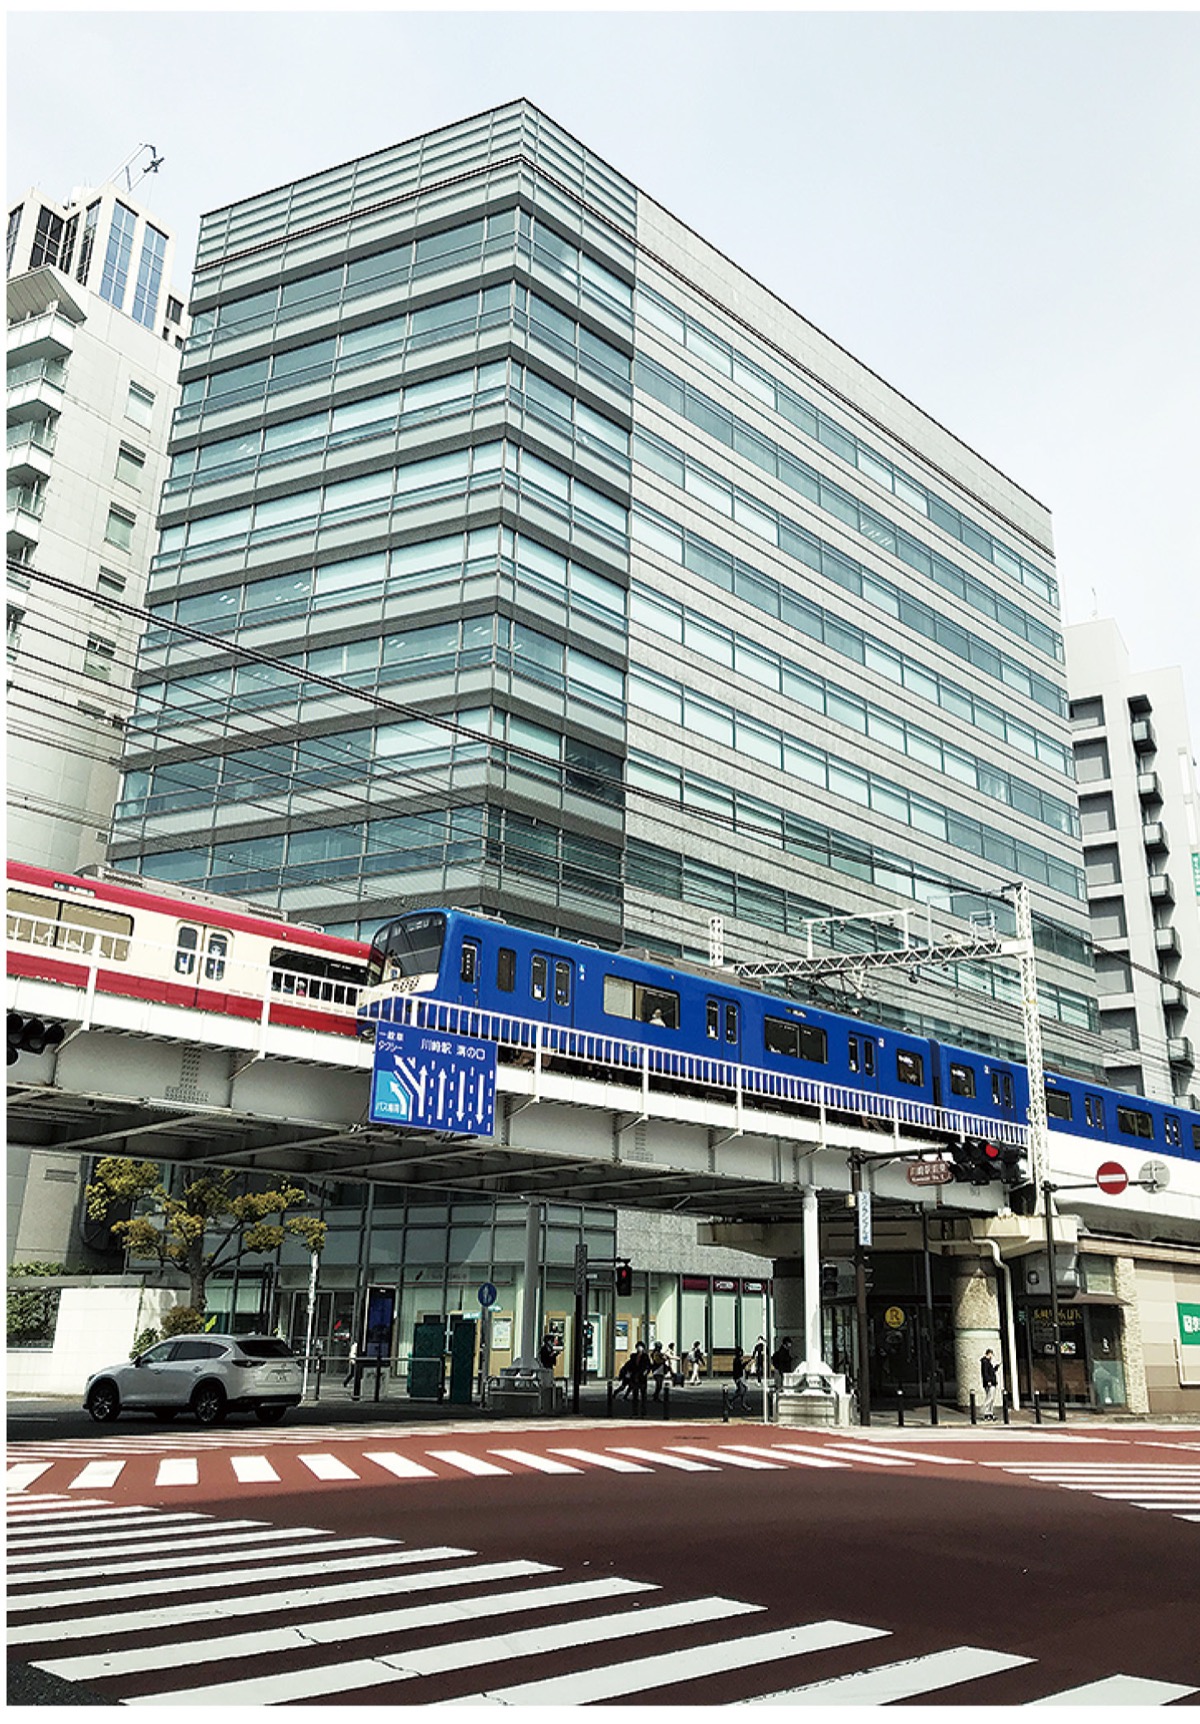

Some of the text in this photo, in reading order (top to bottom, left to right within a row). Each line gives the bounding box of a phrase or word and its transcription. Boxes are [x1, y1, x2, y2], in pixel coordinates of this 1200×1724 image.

[378, 1040, 404, 1053] タクシー
[420, 1038, 486, 1061] 川崎駅 溝の口
